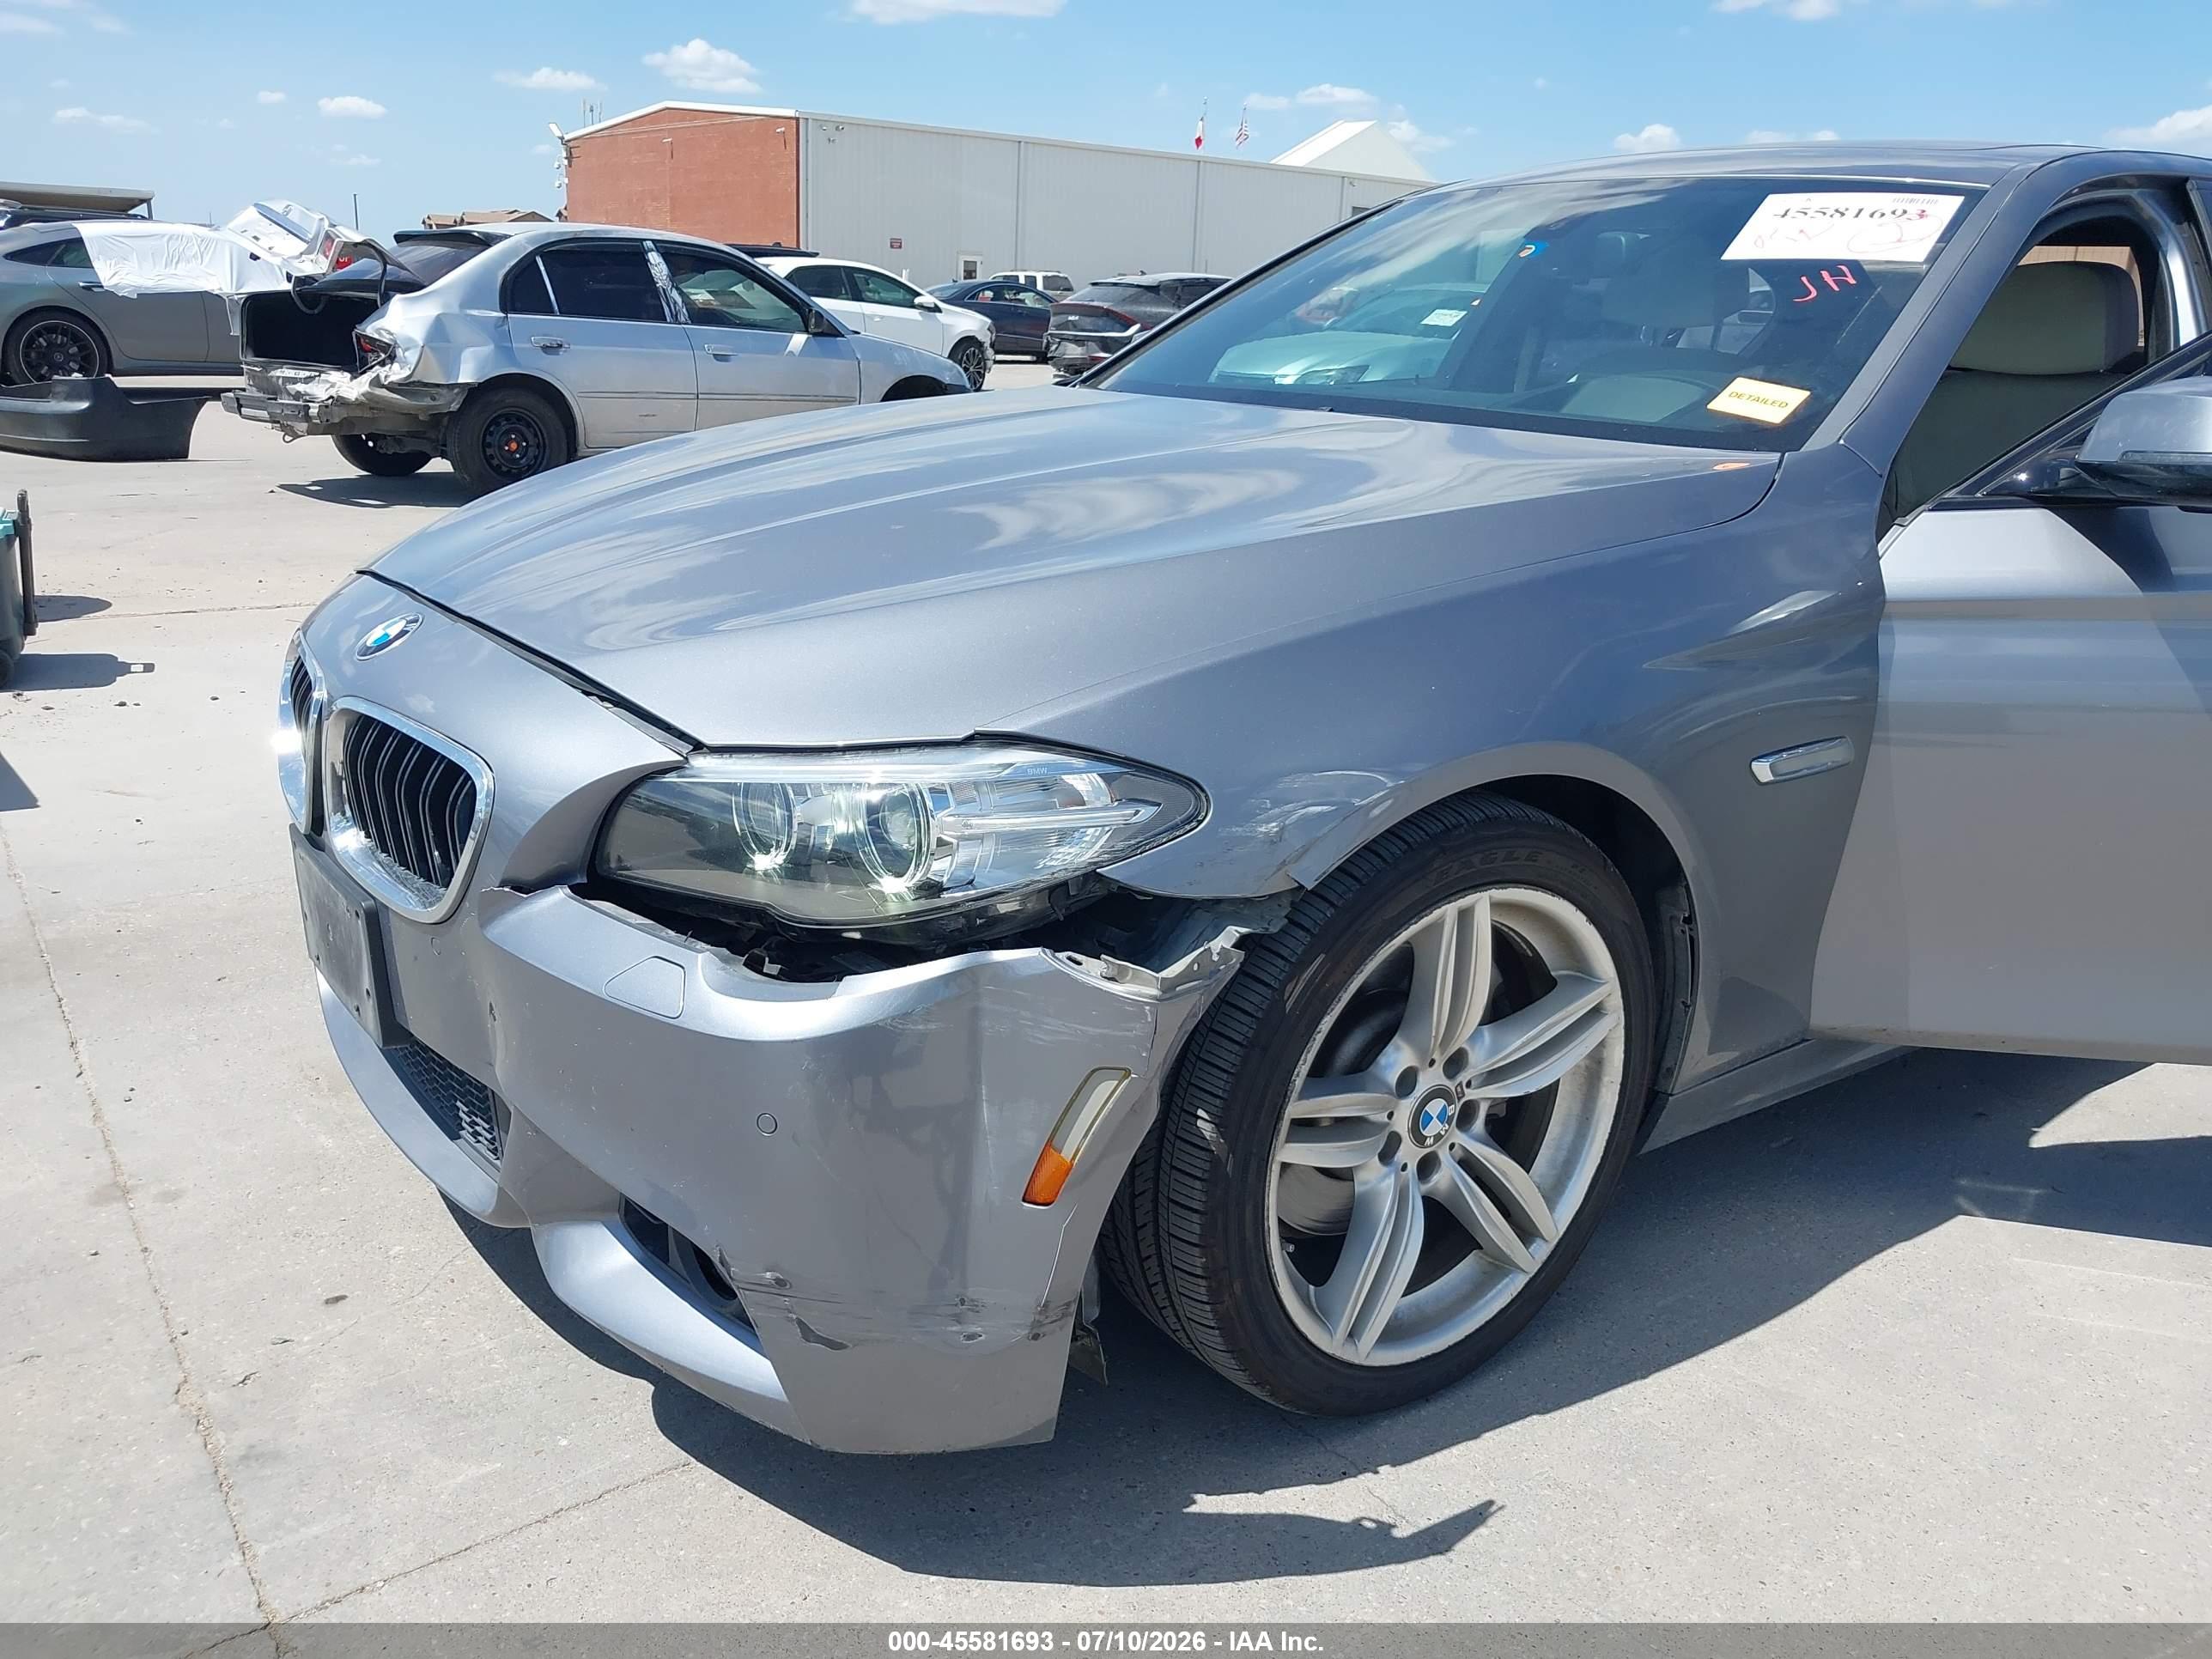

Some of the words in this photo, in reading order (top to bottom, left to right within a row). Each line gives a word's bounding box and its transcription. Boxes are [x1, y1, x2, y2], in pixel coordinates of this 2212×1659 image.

[1729, 391, 1789, 409] DETAILED
[1027, 767, 1048, 775] BMW
[1433, 850, 1545, 885] EAGLE
[1424, 1104, 1455, 1146] BMW
